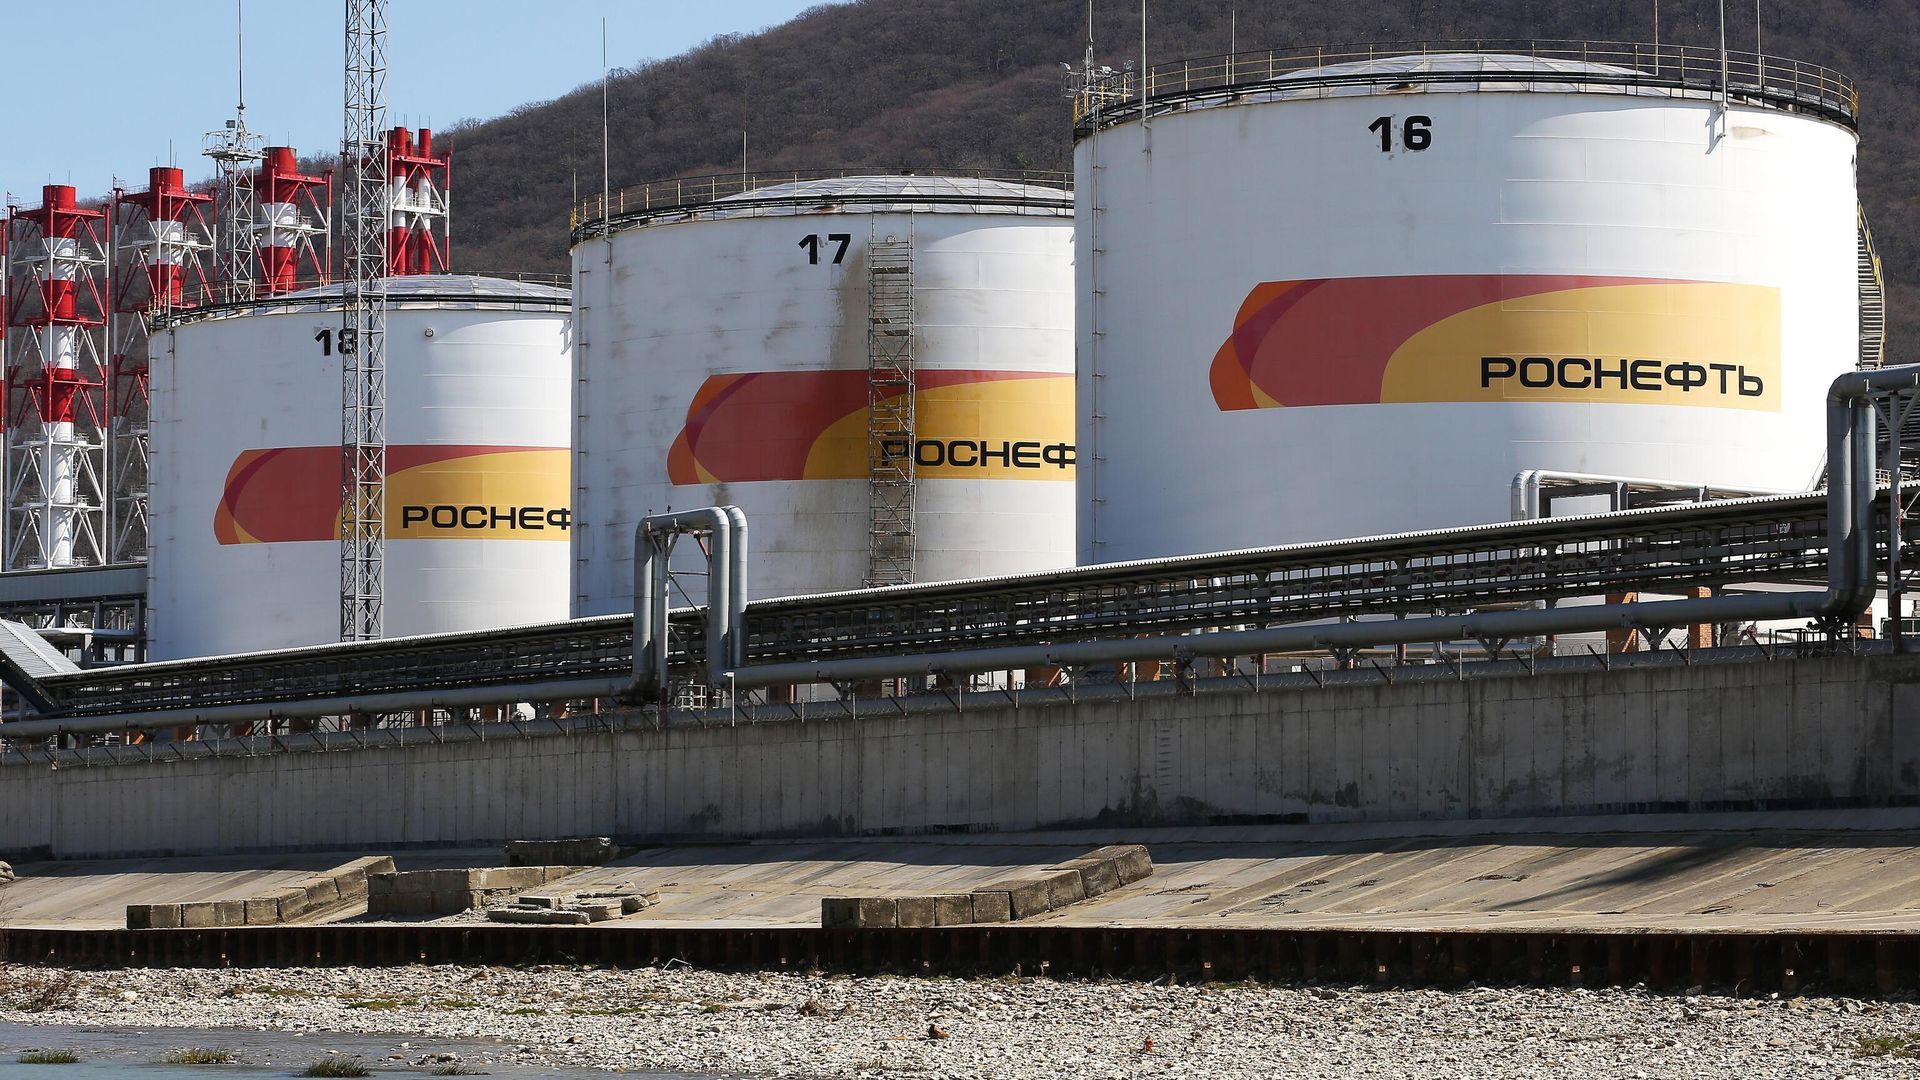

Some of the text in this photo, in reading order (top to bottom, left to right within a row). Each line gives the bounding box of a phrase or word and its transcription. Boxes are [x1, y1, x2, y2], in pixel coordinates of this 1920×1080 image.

[1367, 115, 1432, 152] 16
[798, 233, 852, 265] 17
[314, 328, 358, 356] 18
[1480, 357, 1764, 397] РОСНЕФТЬ
[881, 440, 1077, 469] РОСНЕФ
